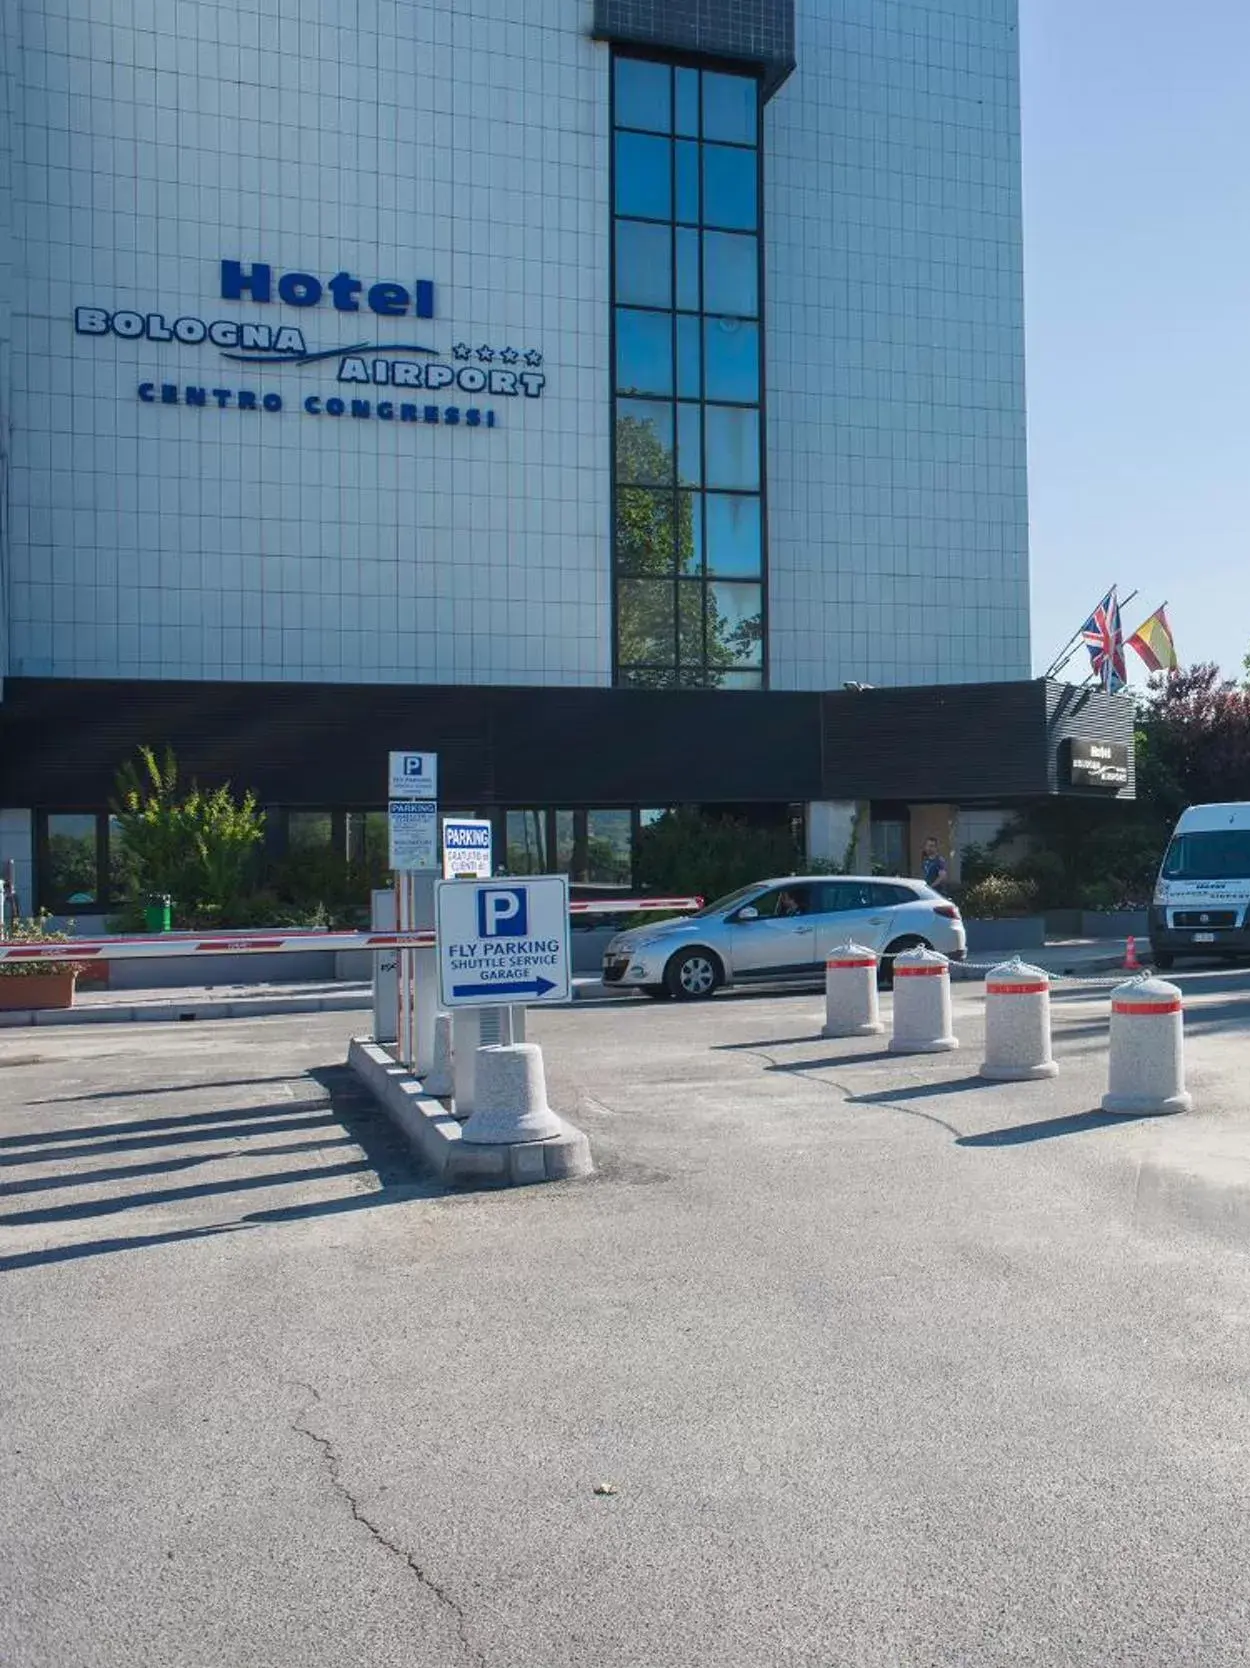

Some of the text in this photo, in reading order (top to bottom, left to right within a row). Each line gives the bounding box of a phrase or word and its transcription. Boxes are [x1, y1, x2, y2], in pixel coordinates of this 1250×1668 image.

[220, 259, 435, 319] Hotel
[74, 306, 308, 354] BOLOGNA
[337, 356, 546, 398] AIRPORT
[137, 381, 497, 428] CENTRO CONGRESSI
[406, 757, 420, 775] P
[392, 804, 434, 813] PARKING
[447, 828, 489, 846] PARKING
[485, 891, 520, 935] P
[449, 939, 560, 957] FLY PARKING
[451, 954, 558, 970] SHUTTLE SERVICE
[480, 967, 530, 980] GARAGE
